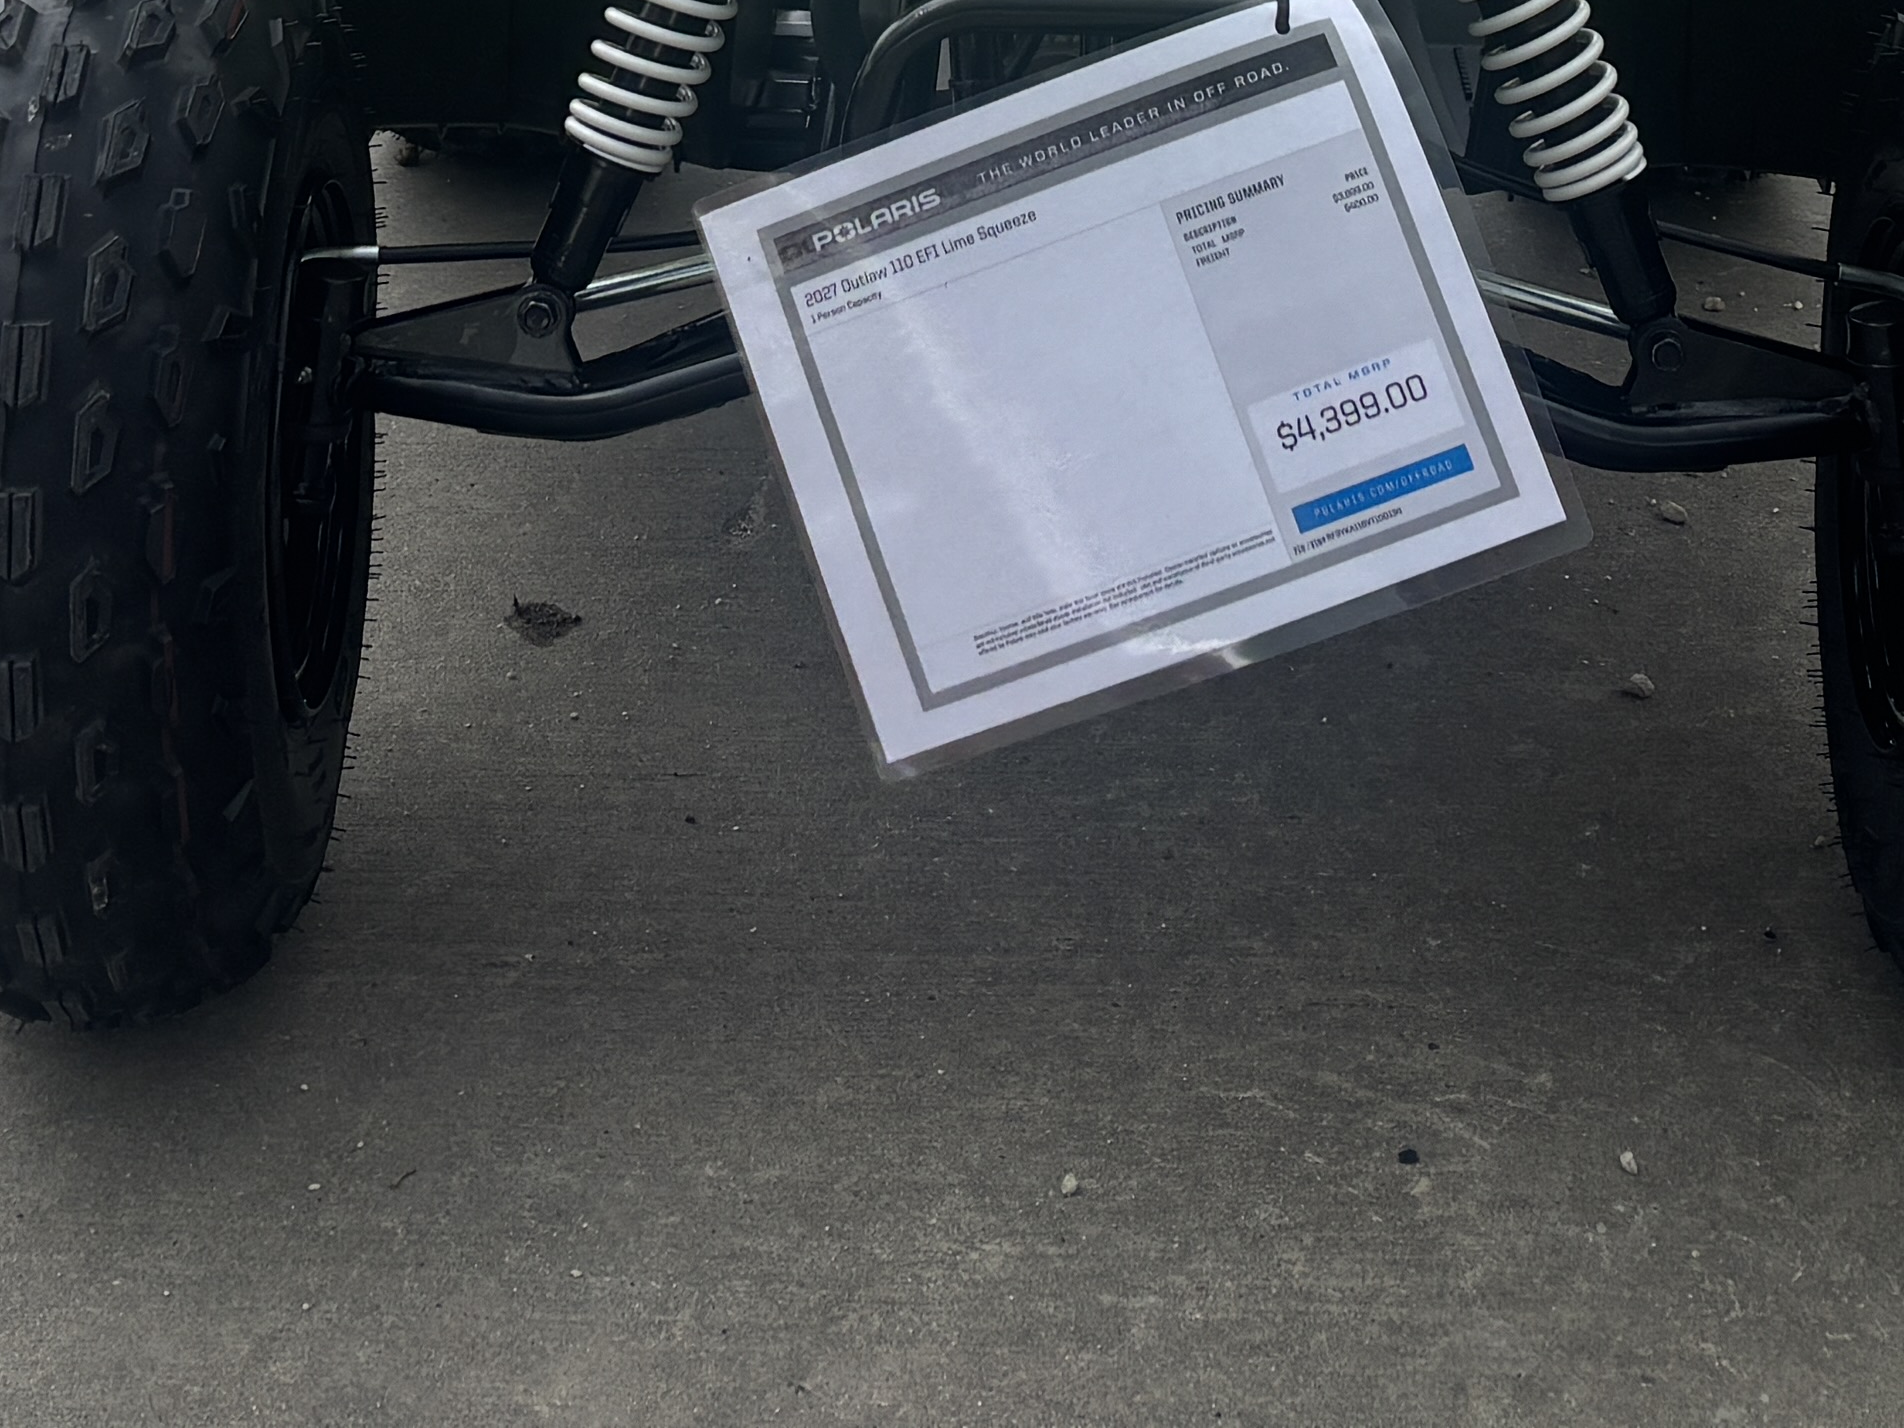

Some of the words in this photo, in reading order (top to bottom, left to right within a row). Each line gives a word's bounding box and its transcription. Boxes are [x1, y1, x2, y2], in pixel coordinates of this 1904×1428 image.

[811, 187, 942, 253] POLARIS
[976, 161, 1014, 185] THE
[1018, 135, 1083, 169] WORLD
[1089, 106, 1160, 143] LEADER
[1167, 96, 1187, 114] IN
[1193, 81, 1227, 104] OFF
[1234, 61, 1290, 89] ROAD.
[1176, 194, 1227, 225] PRICING
[1227, 174, 1286, 205] SUMMARY
[805, 282, 838, 308] 2027
[841, 265, 889, 294] Outlaw
[889, 254, 915, 276] 110
[916, 244, 941, 265] EFI
[941, 231, 976, 256] Lime
[977, 209, 1038, 242] Squeeze
[1191, 239, 1217, 255] TOTAL
[817, 304, 847, 322] Person
[846, 291, 883, 311] Capacity
[1276, 373, 1428, 452] $4,399.00
[1292, 376, 1342, 401] TOTAL
